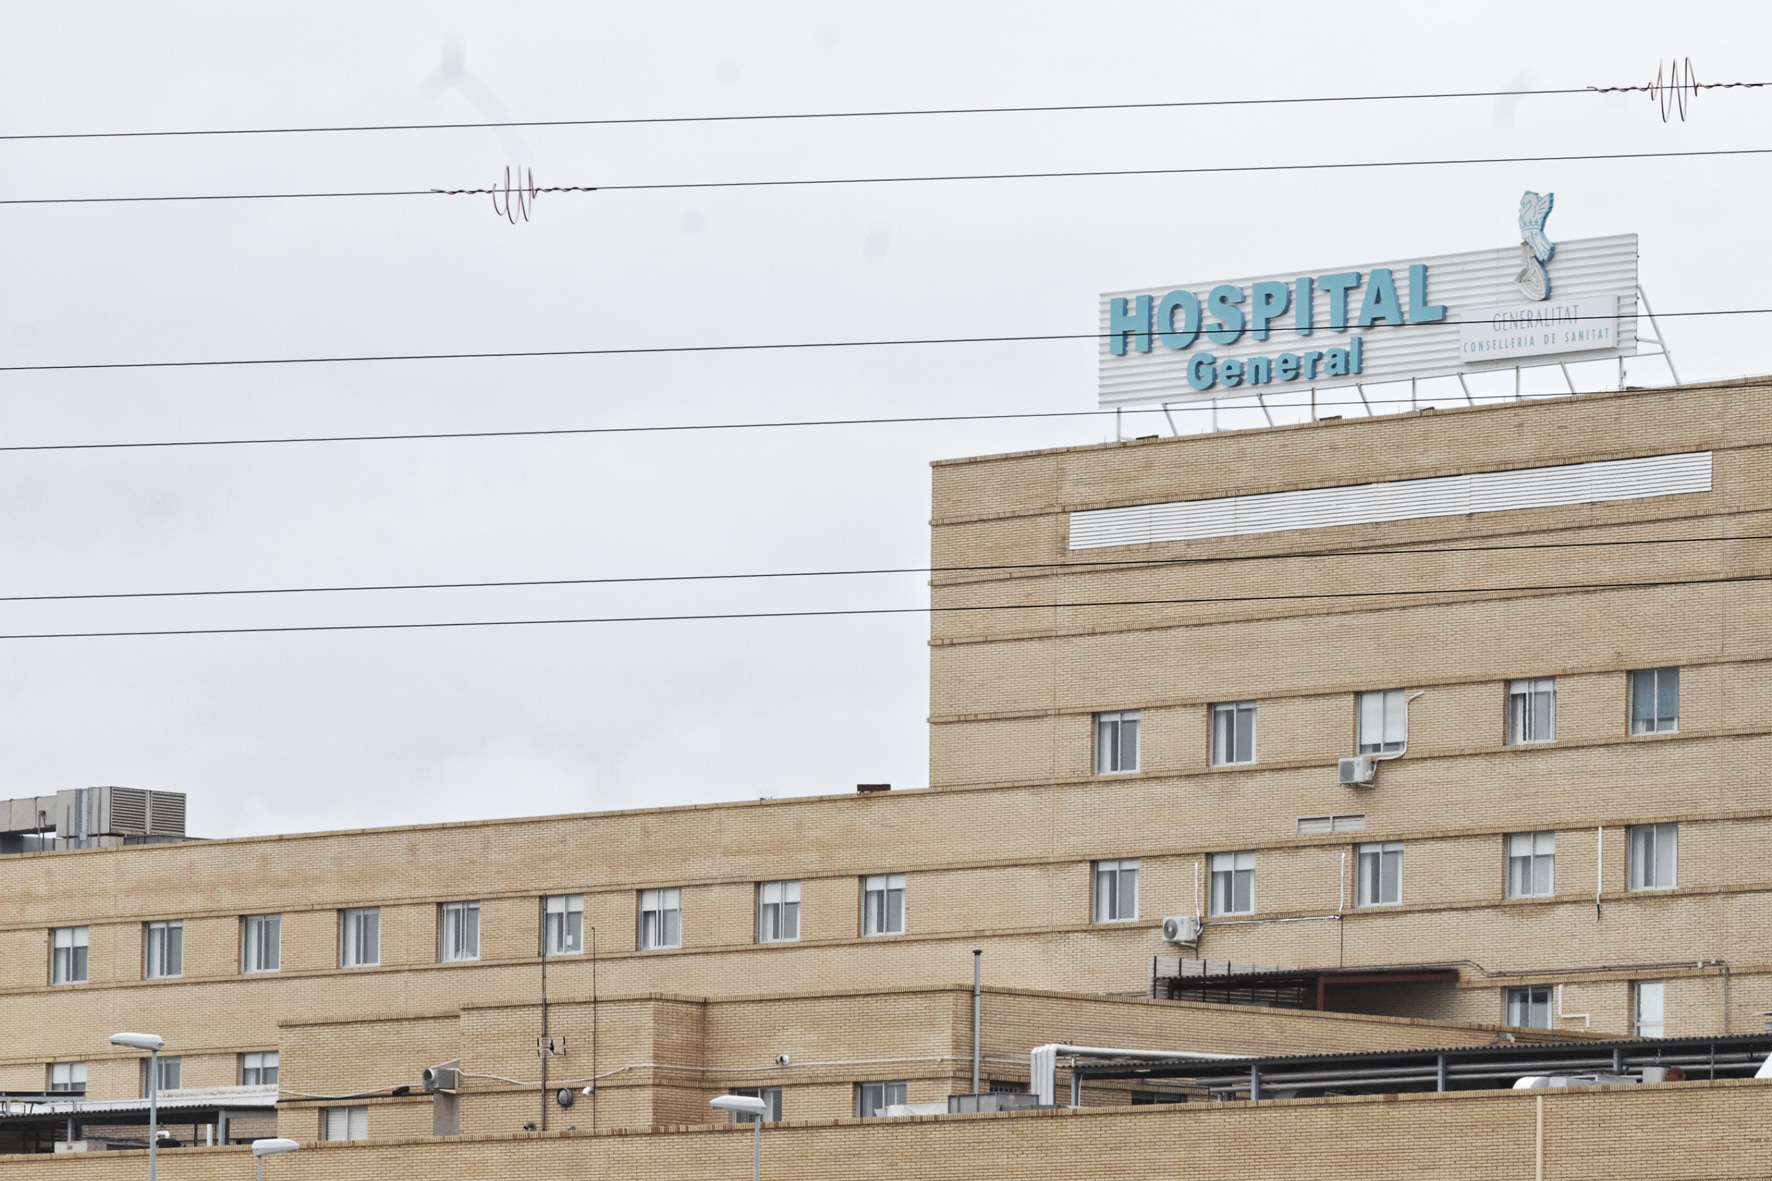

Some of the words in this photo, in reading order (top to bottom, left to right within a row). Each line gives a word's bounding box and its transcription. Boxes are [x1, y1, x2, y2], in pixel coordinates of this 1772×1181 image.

[1109, 264, 1446, 355] HOSPITAL
[1493, 305, 1579, 332] GENERALITAT
[1463, 335, 1535, 353] CONSELLERIA
[1544, 333, 1556, 345] DE
[1565, 328, 1610, 343] SANITAT
[1186, 337, 1363, 391] General
